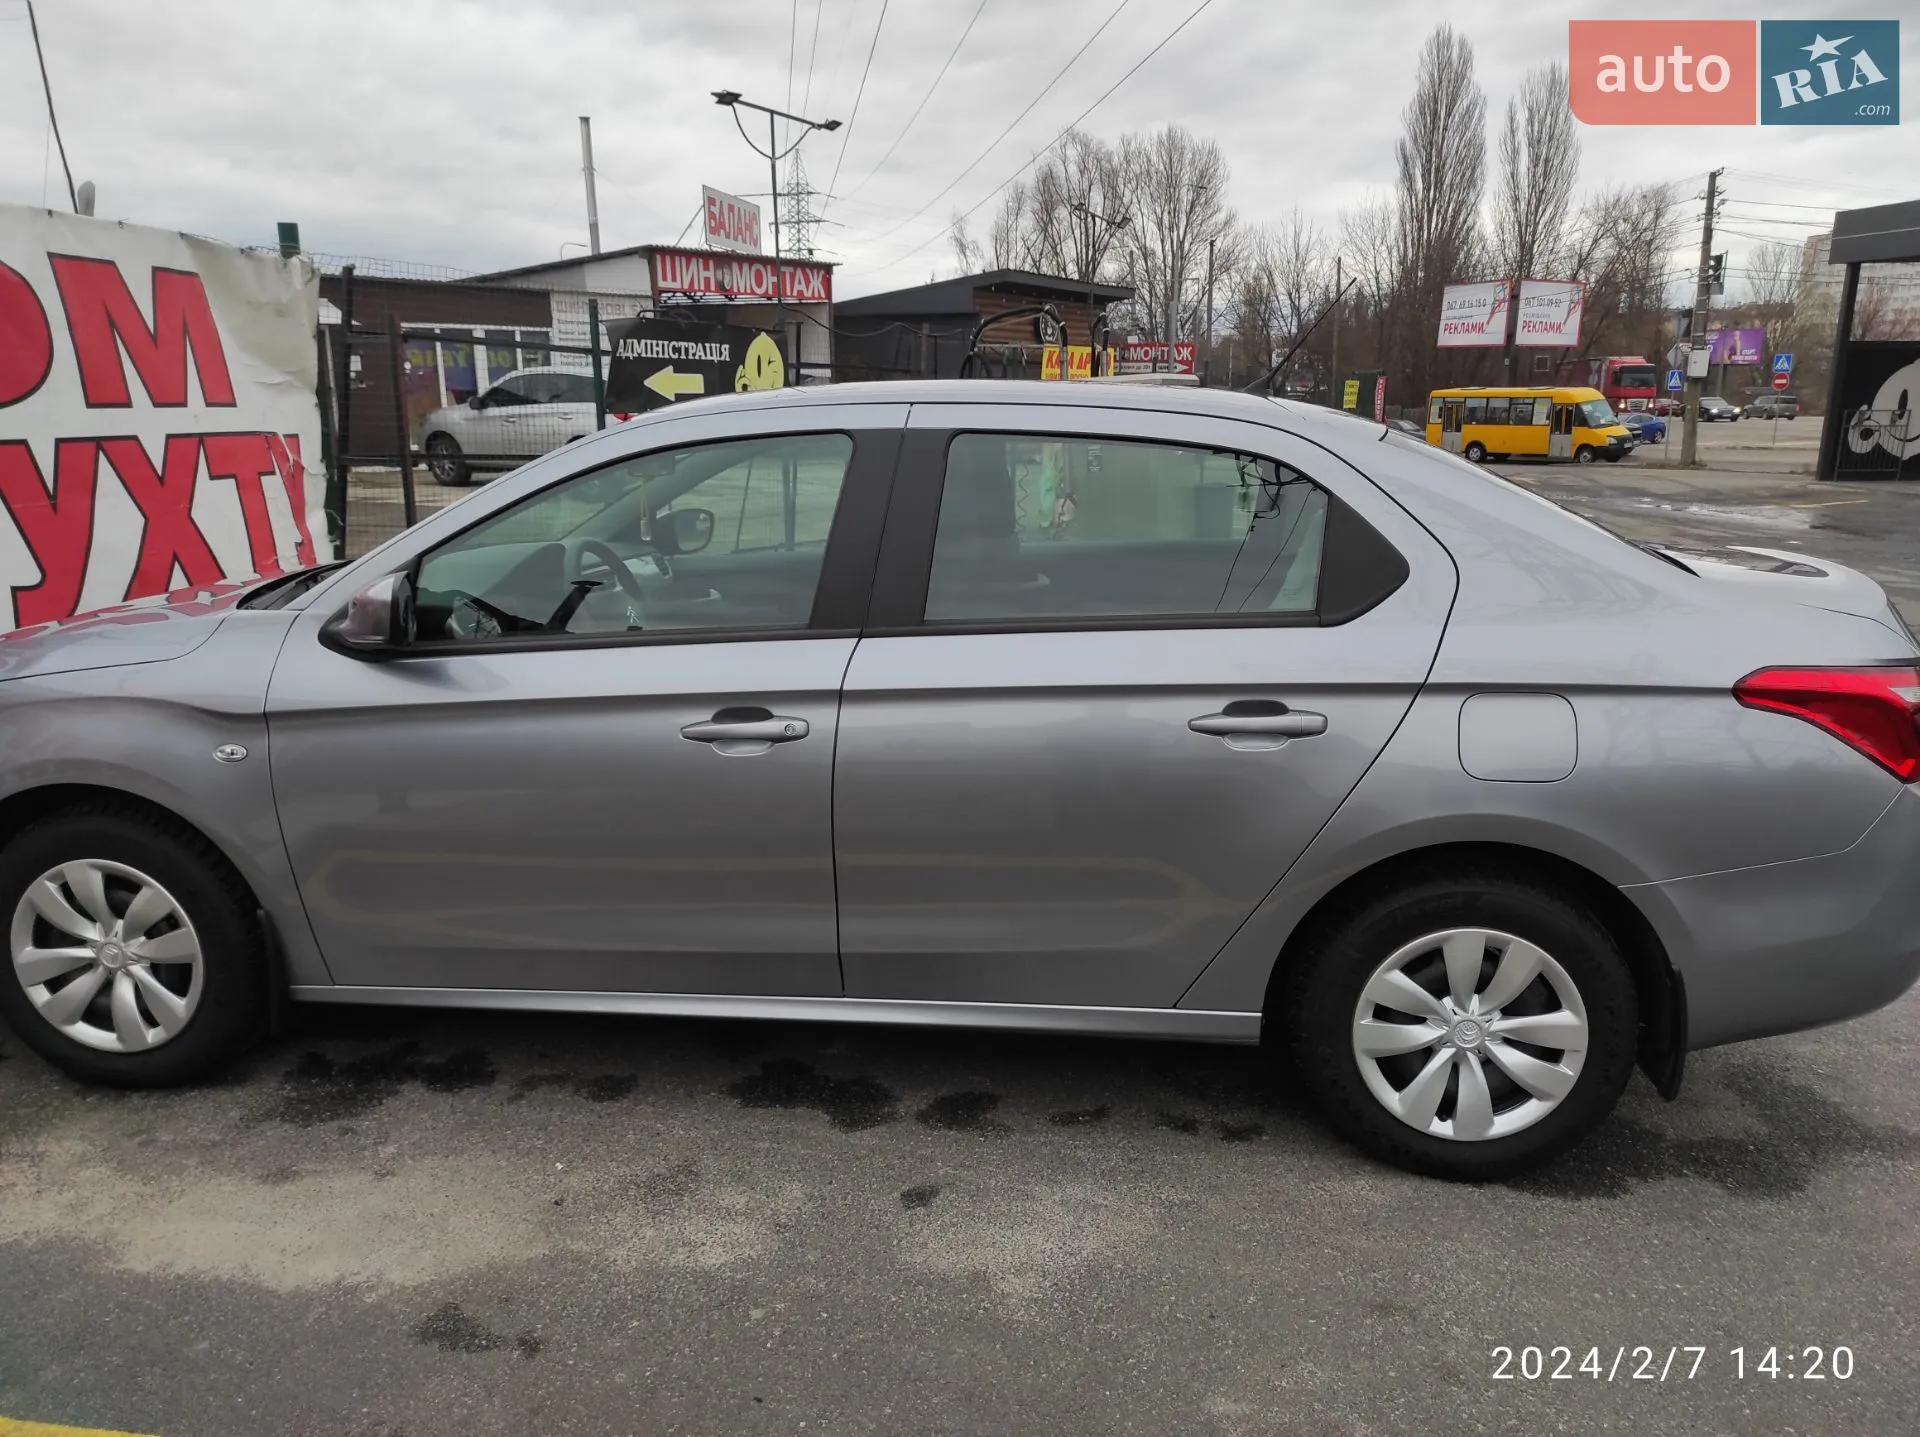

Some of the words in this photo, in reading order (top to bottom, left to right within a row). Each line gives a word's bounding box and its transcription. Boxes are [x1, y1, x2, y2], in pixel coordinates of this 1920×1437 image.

[707, 196, 760, 249] БАЛАНС
[1443, 321, 1485, 335] РЕКЛАМИ
[1521, 320, 1564, 334] РЕКЛАМИ
[615, 338, 731, 363] АДМІНІСТРАЦІЯ
